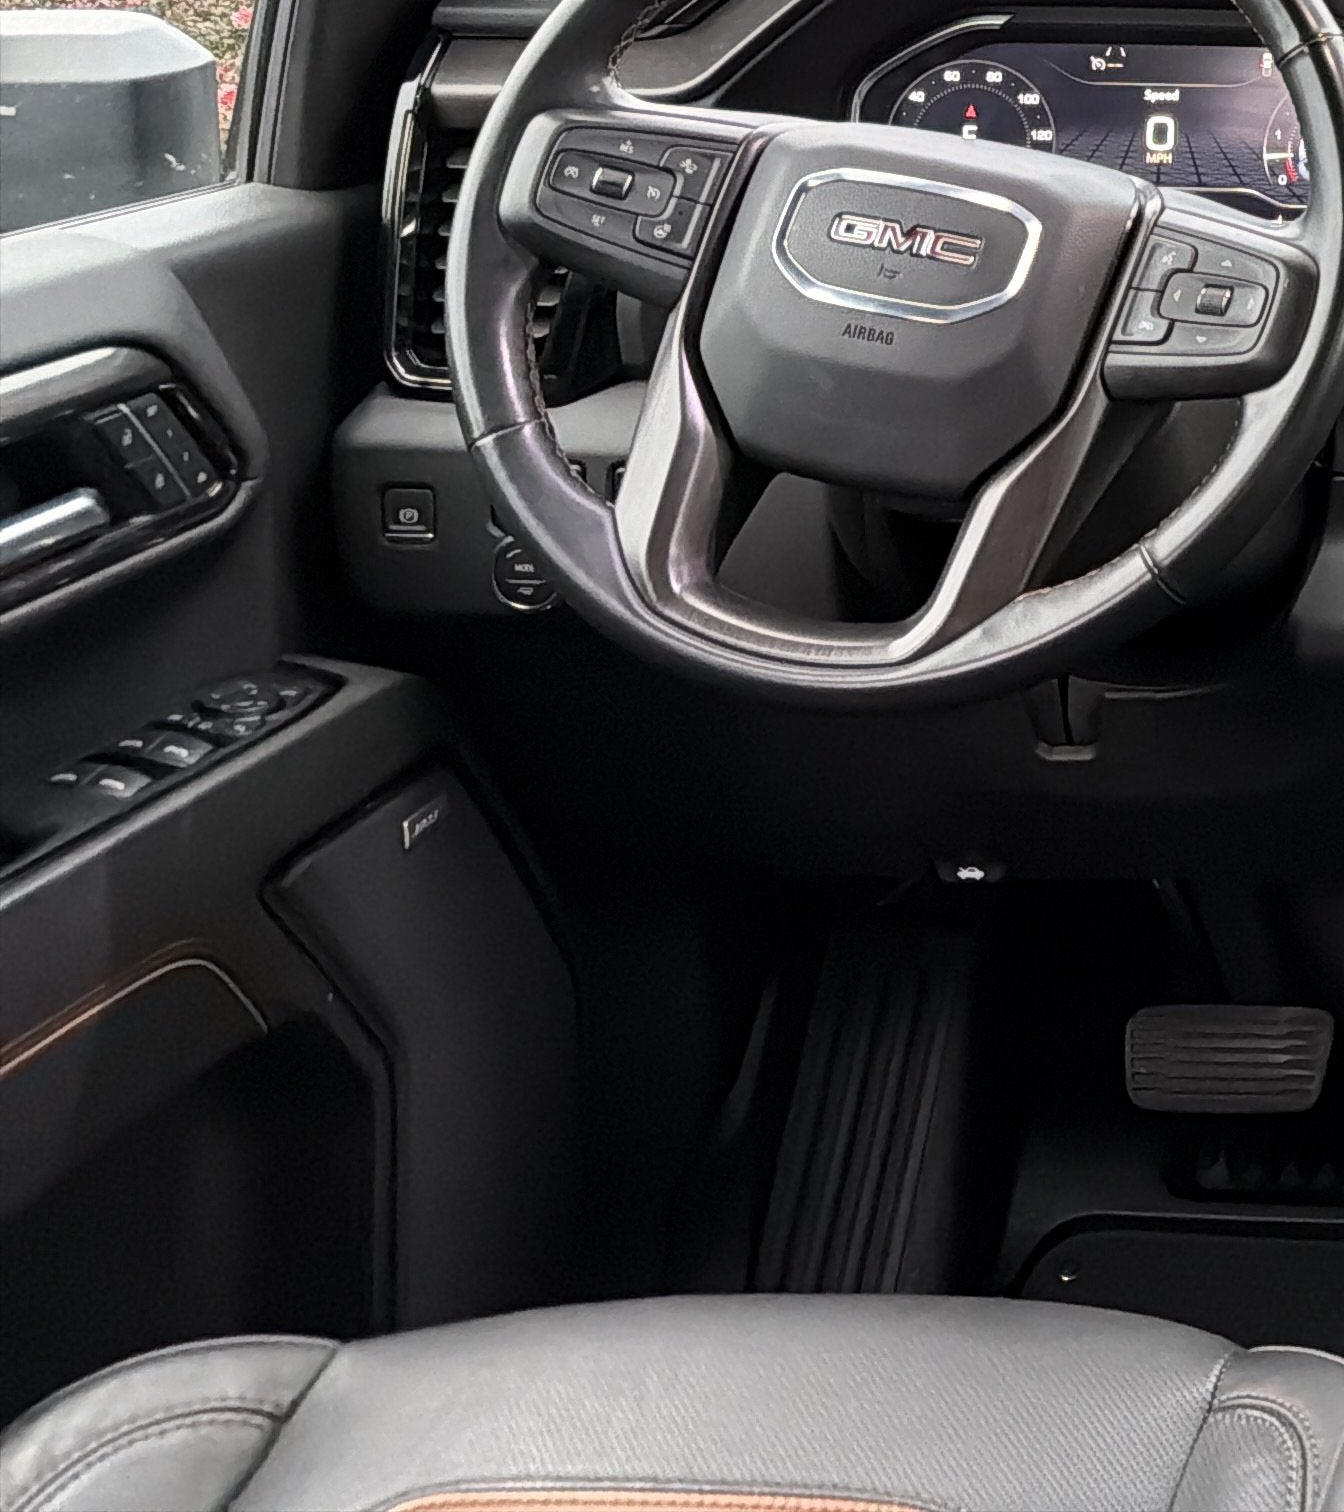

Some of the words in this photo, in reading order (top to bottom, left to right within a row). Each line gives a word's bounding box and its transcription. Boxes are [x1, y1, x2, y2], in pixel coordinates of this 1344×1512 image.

[943, 70, 960, 82] 60
[908, 91, 925, 103] 40
[1016, 93, 1040, 105] 100
[1144, 89, 1180, 103] Speed
[1030, 129, 1052, 141] 120
[1145, 115, 1175, 152] 0
[1146, 152, 1173, 164] MPH
[1277, 174, 1287, 186] 0
[829, 213, 983, 266] GMC
[842, 323, 895, 346] AIRBAG
[514, 563, 535, 573] MODE
